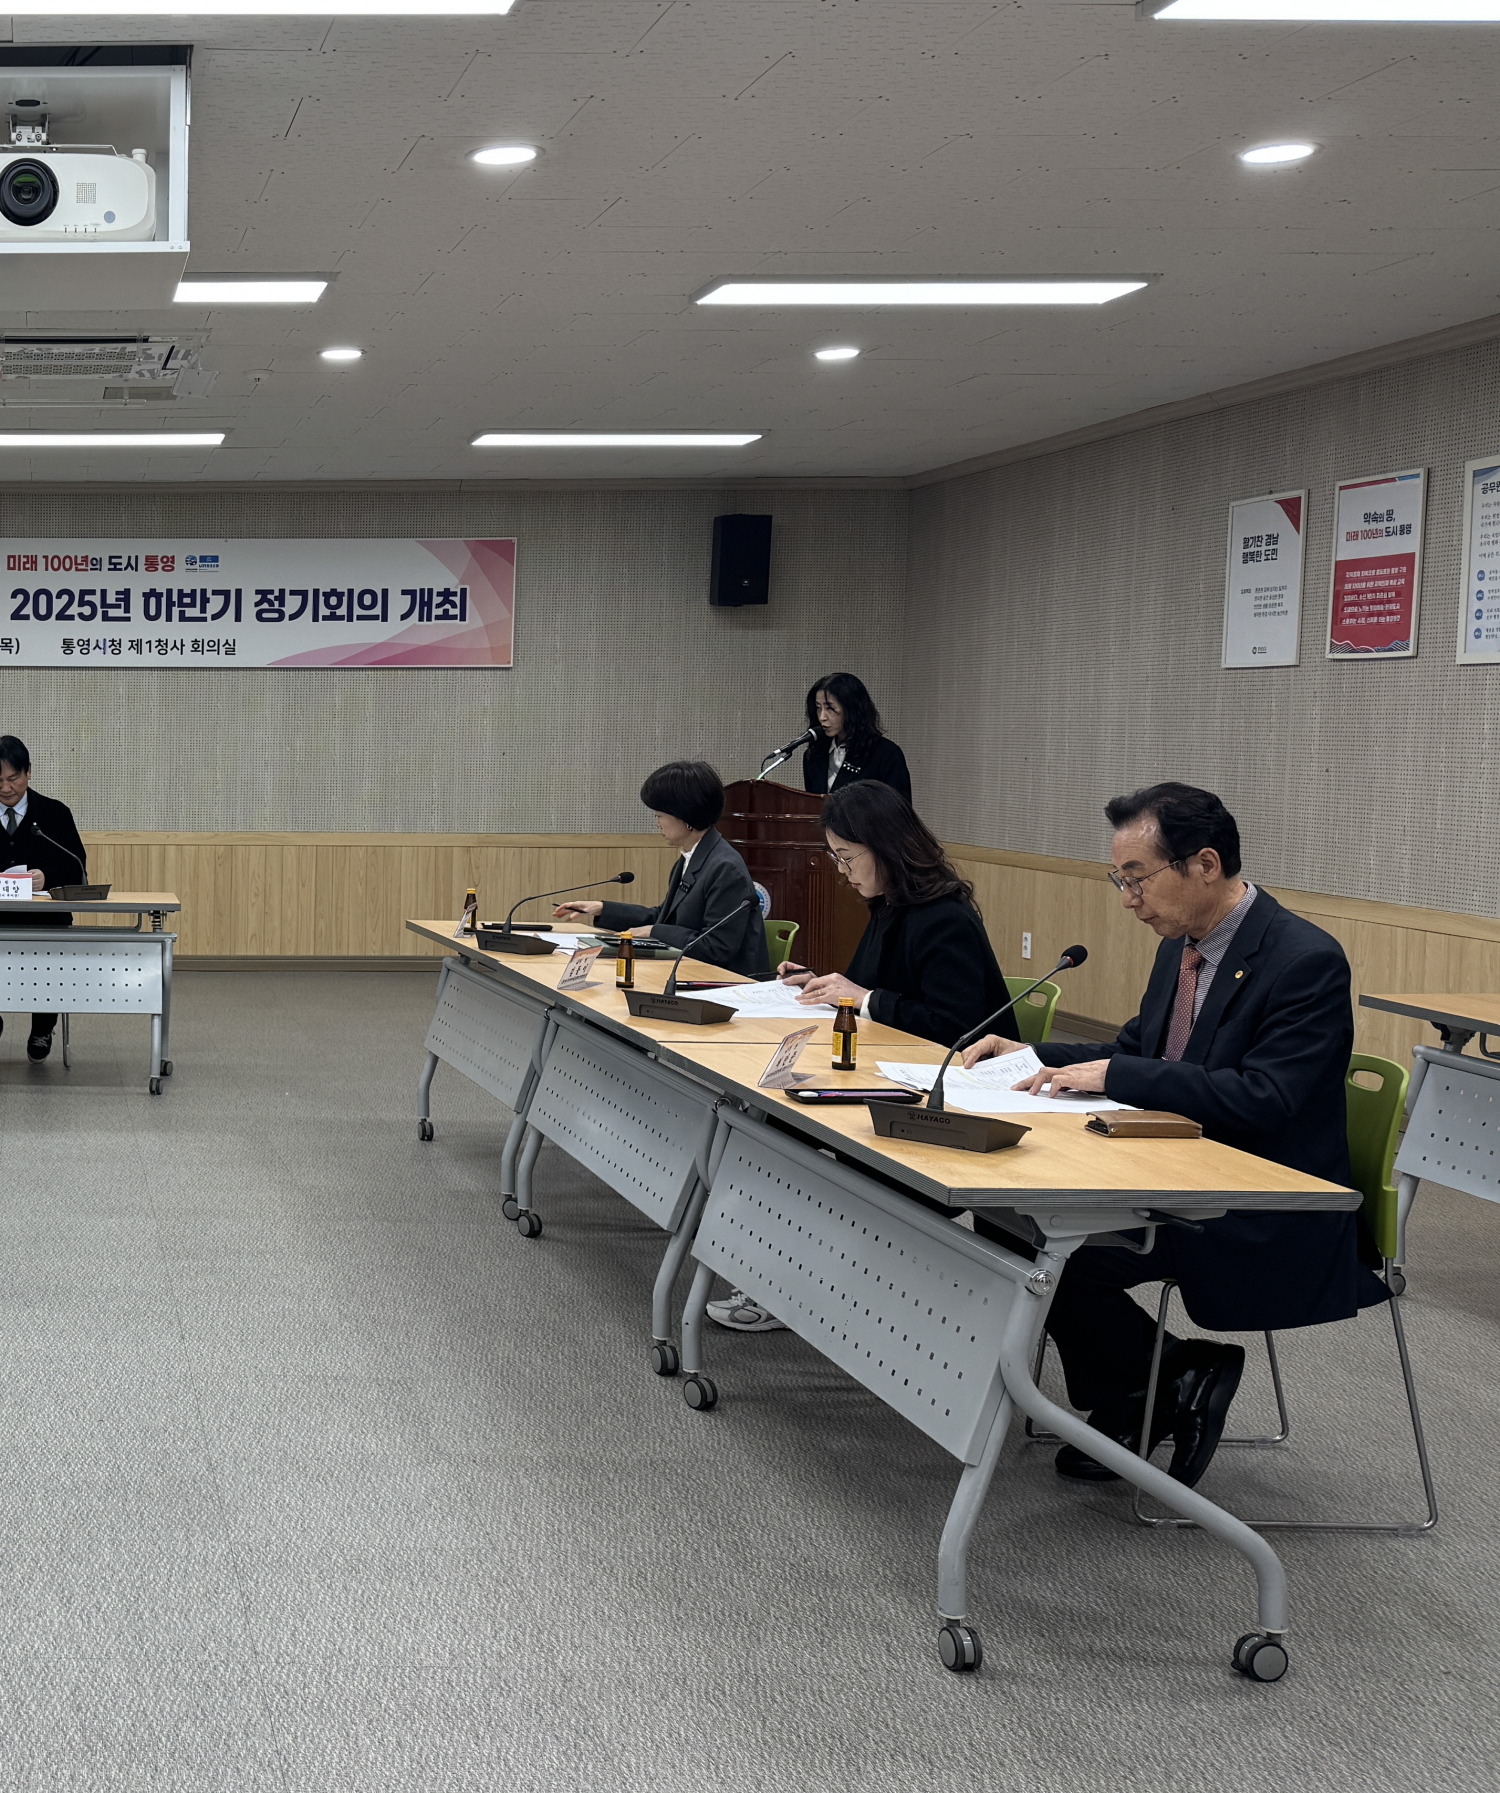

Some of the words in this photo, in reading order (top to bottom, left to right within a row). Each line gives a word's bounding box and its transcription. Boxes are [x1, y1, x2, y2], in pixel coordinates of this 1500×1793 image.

[1363, 511, 1384, 524] 약속의
[1243, 535, 1263, 549] 활기찬
[1265, 532, 1279, 546] 경남
[1346, 531, 1359, 541] 미래
[1360, 528, 1383, 540] 100년의
[1385, 525, 1397, 537] 도시
[1399, 523, 1412, 535] 통영
[6, 554, 38, 572] 미래
[42, 554, 102, 572] 100년의
[107, 554, 139, 572] 도시
[143, 555, 175, 572] 통영
[1242, 550, 1262, 564] 행복한
[1264, 548, 1278, 561] 도민
[10, 587, 132, 622] 2025년
[141, 587, 243, 623] 하반기
[253, 587, 389, 623] 정기회의
[399, 587, 468, 623] 개최
[60, 638, 123, 655] 통영시청
[127, 638, 186, 655] 제1청사
[190, 638, 237, 656] 회의실
